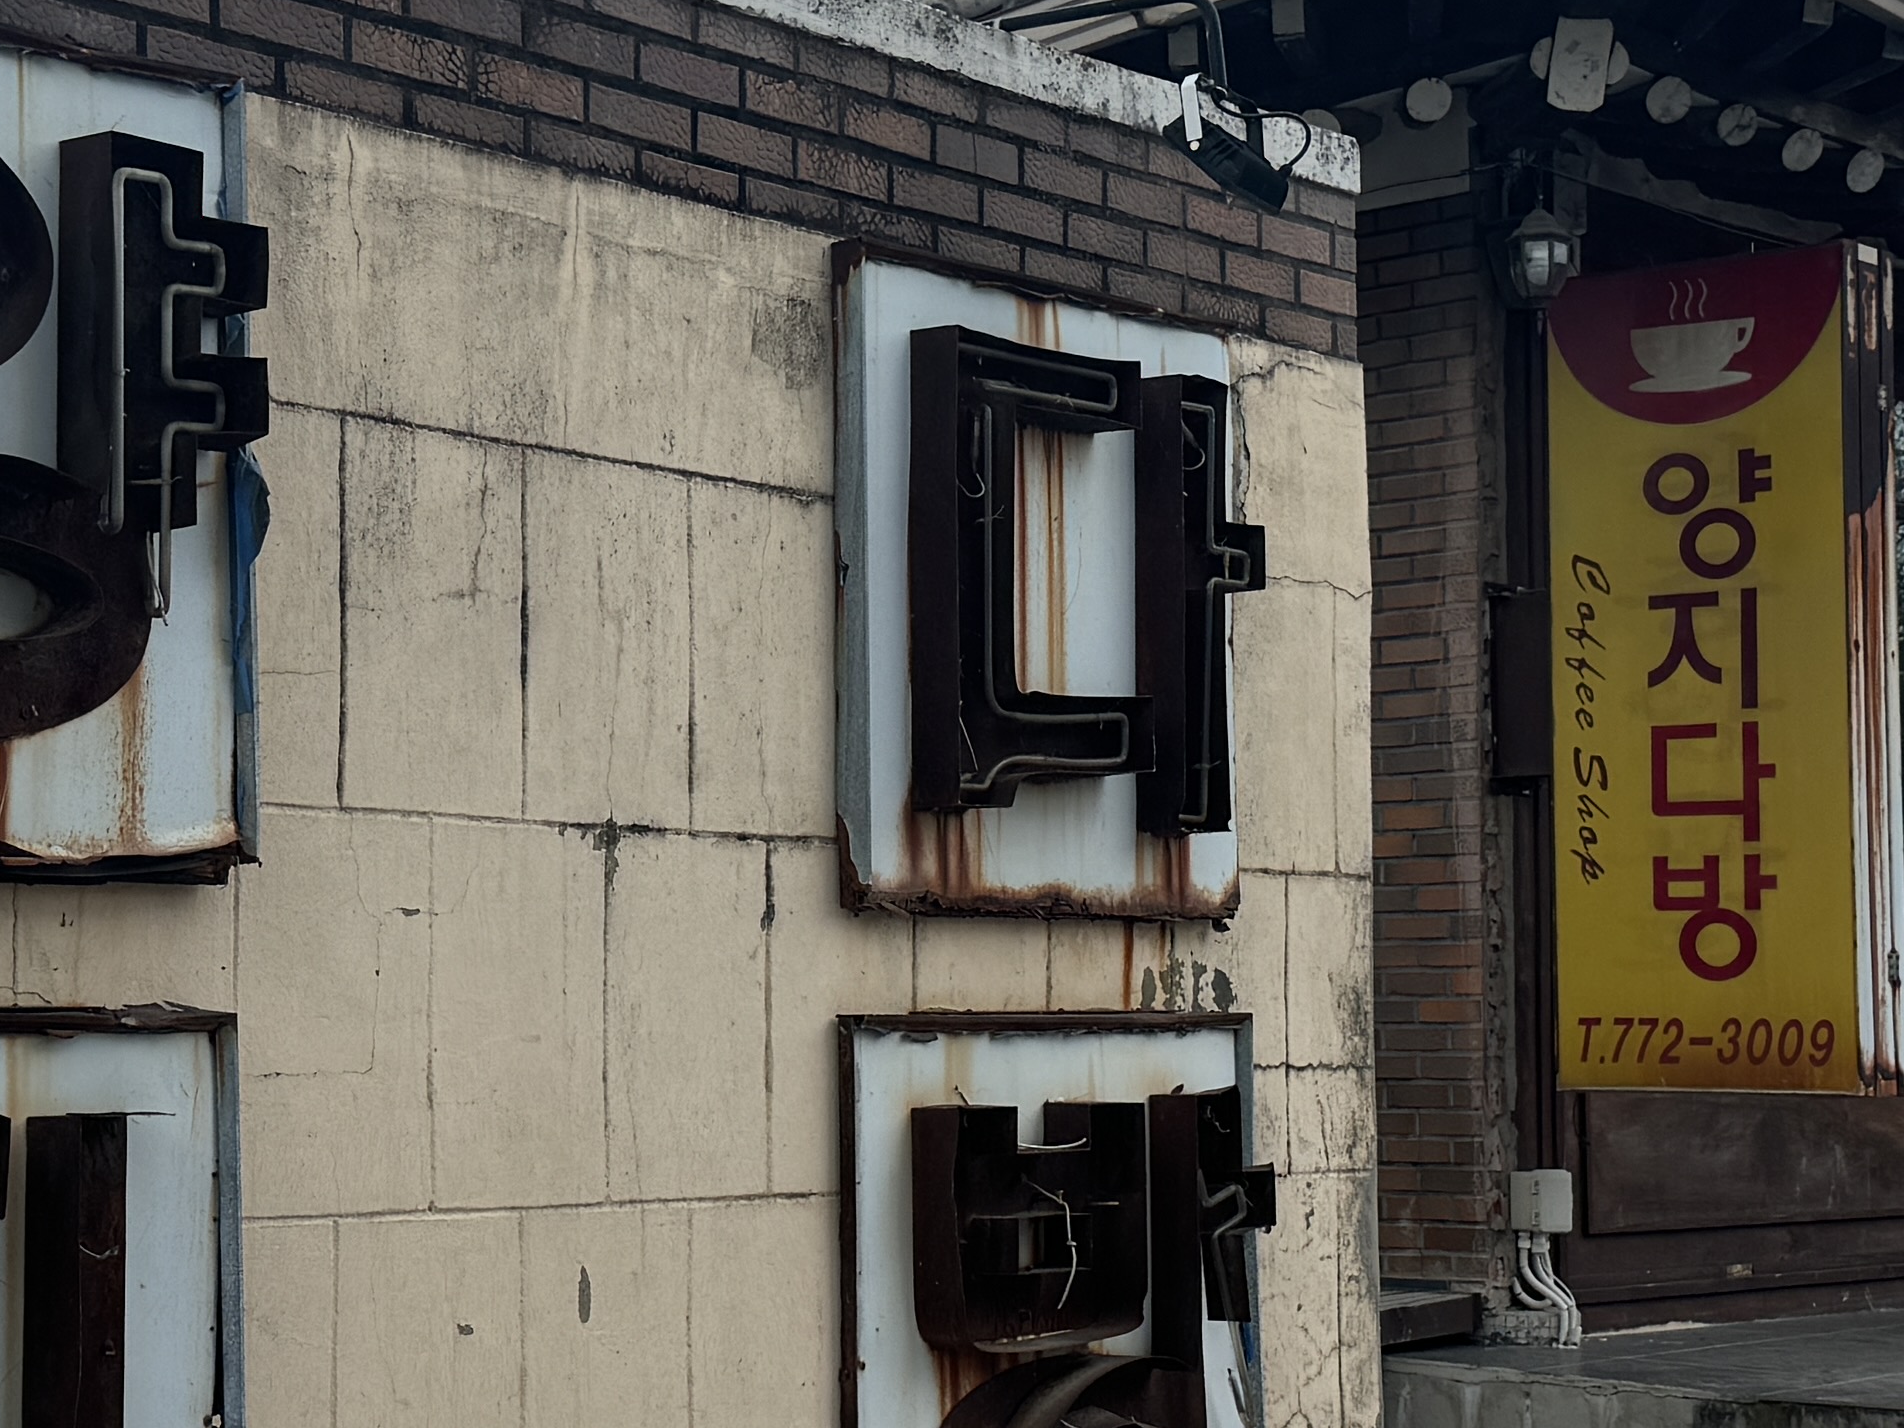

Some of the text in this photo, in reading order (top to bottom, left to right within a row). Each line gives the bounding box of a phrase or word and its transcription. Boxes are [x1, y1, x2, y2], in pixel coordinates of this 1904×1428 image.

[1565, 554, 1611, 885] Coffee Shop
[1643, 448, 1777, 981] 양지다방
[1577, 1017, 1835, 1067] T.772-3009
